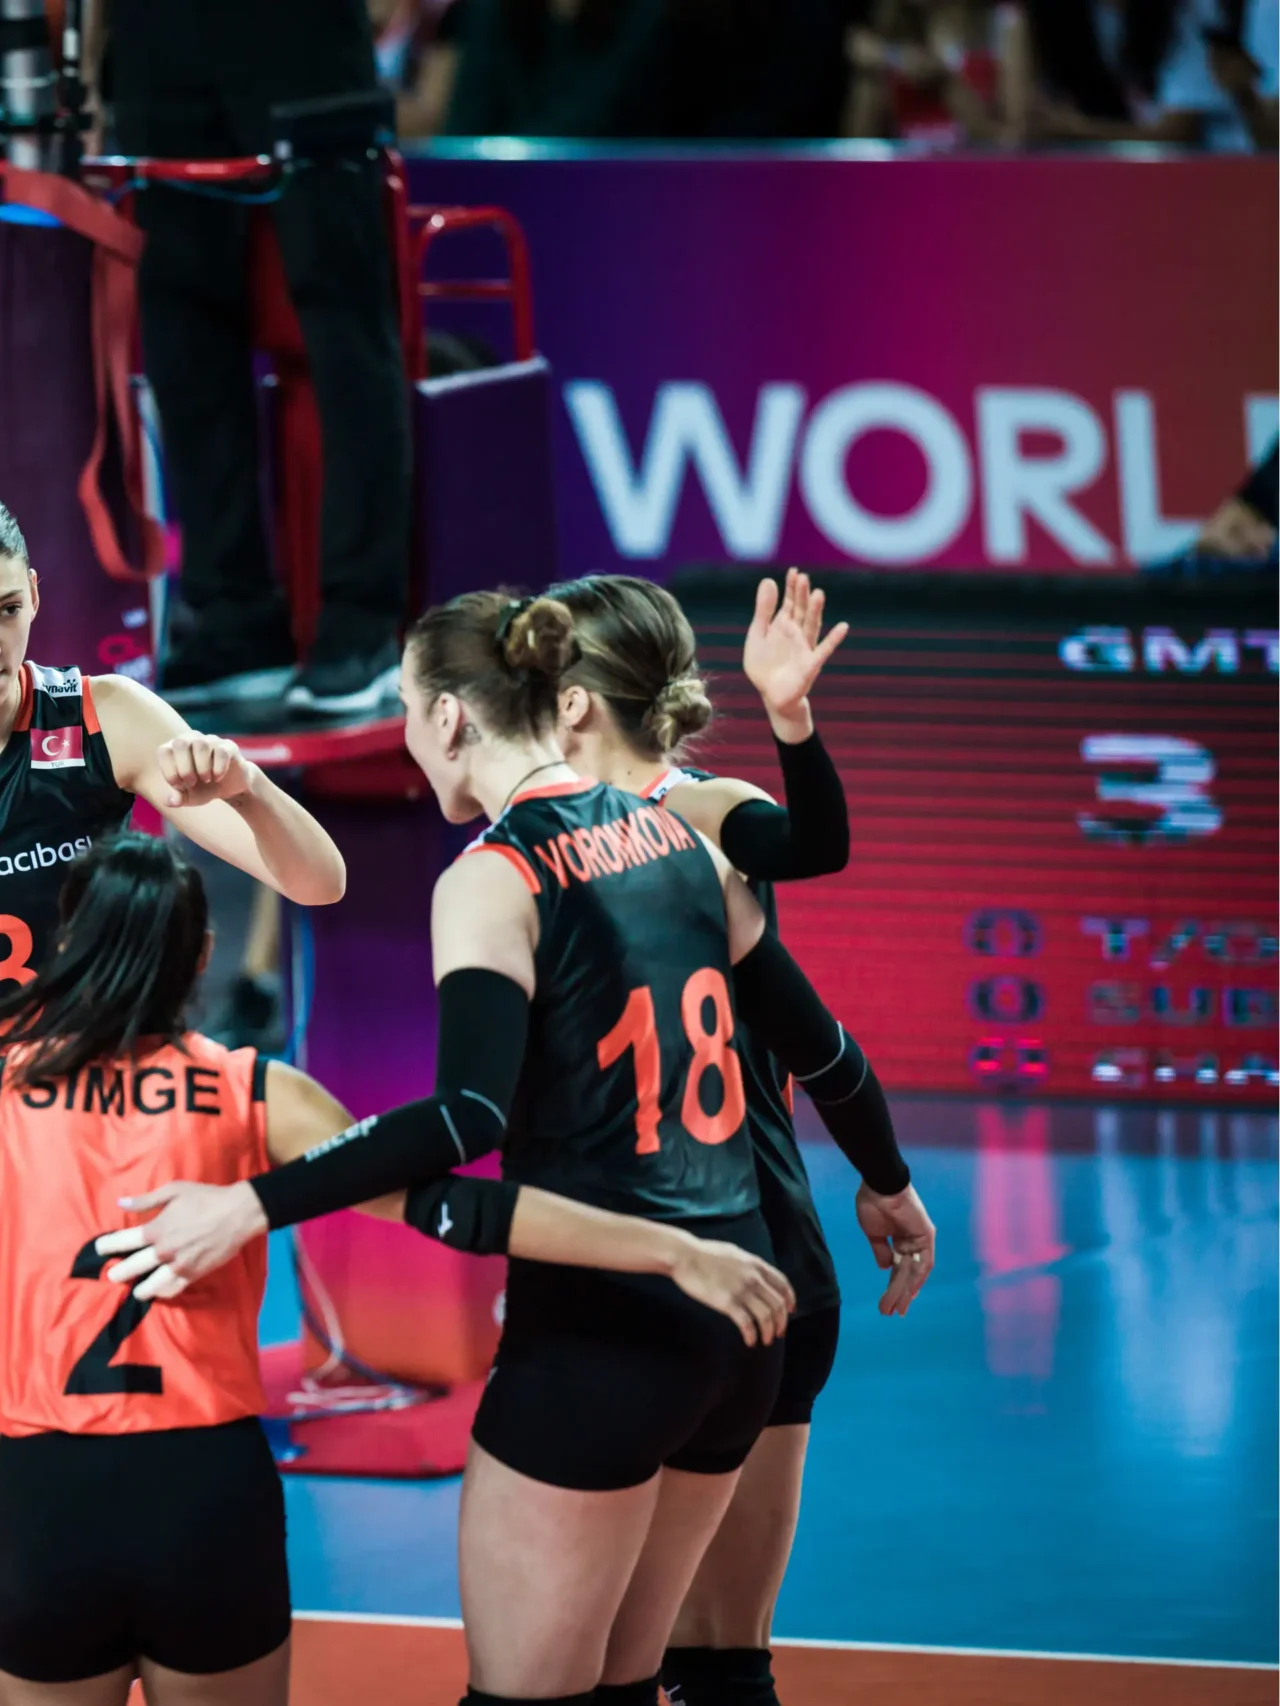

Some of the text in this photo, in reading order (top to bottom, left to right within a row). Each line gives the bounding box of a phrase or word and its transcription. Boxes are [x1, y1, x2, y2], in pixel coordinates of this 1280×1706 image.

[1077, 732, 1222, 847] 3
[597, 967, 746, 1155] 18
[64, 1229, 163, 1396] 2
